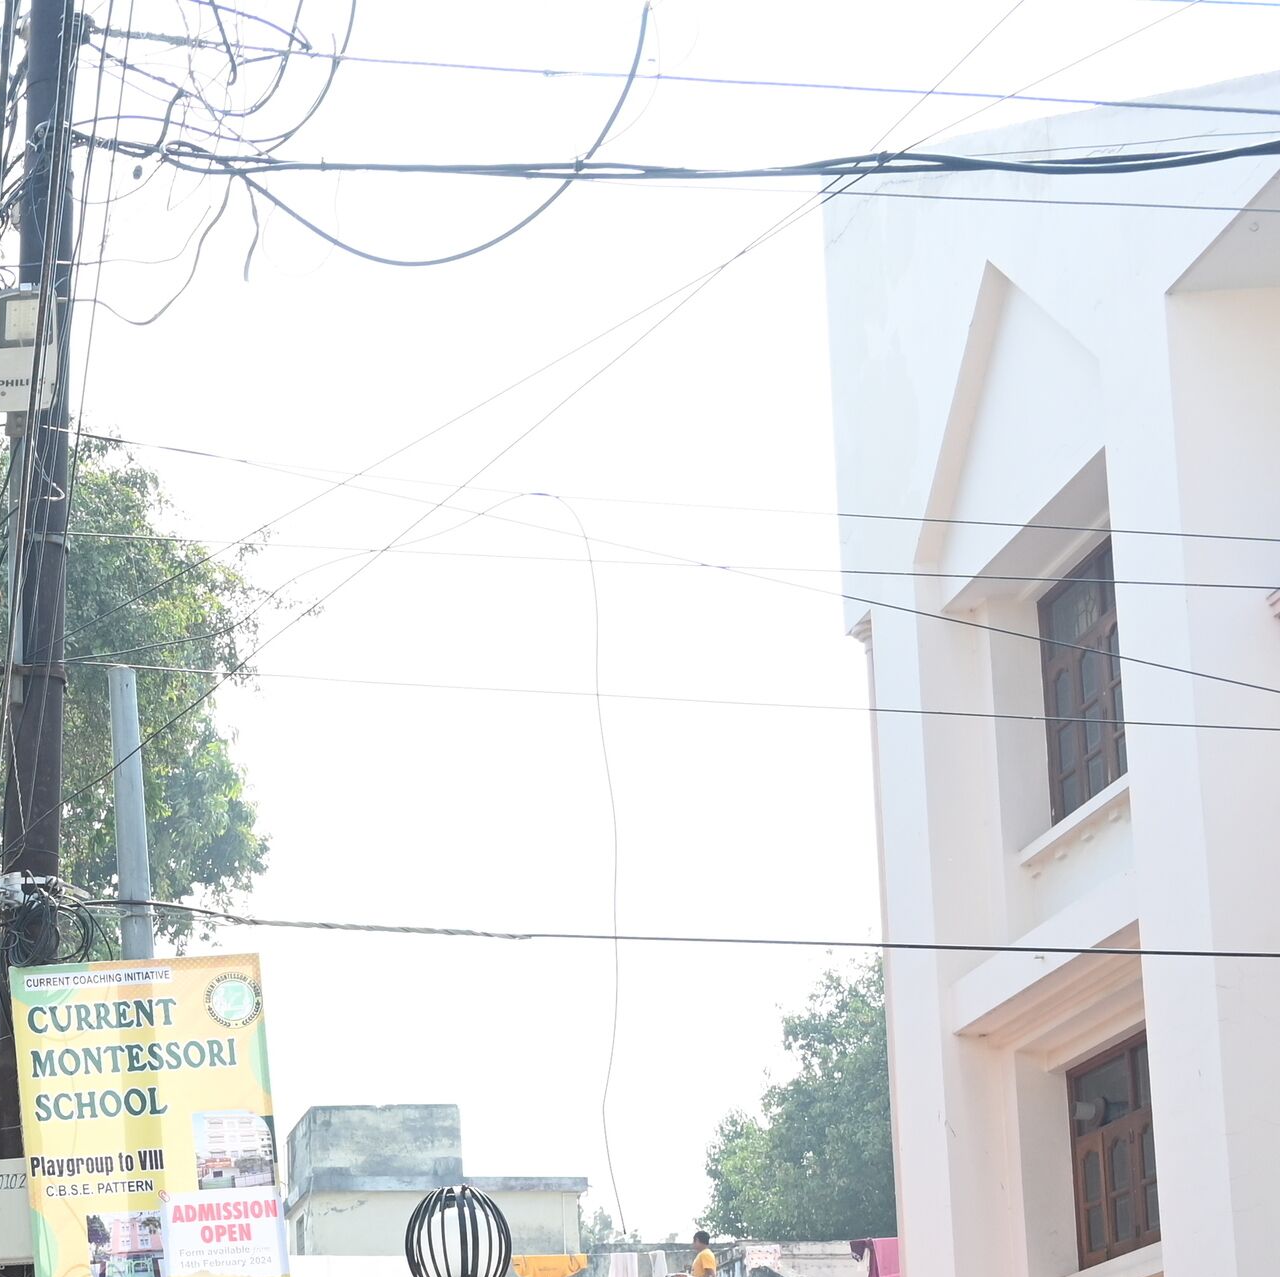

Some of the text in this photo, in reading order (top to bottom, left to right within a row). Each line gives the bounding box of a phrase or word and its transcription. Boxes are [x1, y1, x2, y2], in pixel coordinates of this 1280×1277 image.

[26, 970, 170, 988] CURRENT COACHING INITIATIVE
[28, 998, 176, 1034] CURRENT
[30, 1038, 237, 1078] MONTESSORI
[35, 1087, 168, 1122] SCHOOL
[30, 1149, 164, 1177] Playgroup to VIII
[46, 1180, 153, 1197] C.B.S.E. PATTERN
[172, 1199, 278, 1223] ADMISSION
[200, 1223, 252, 1243] OPEN
[179, 1248, 204, 1257] Form
[207, 1246, 250, 1256] available
[180, 1256, 272, 1269] 14th February 2024
